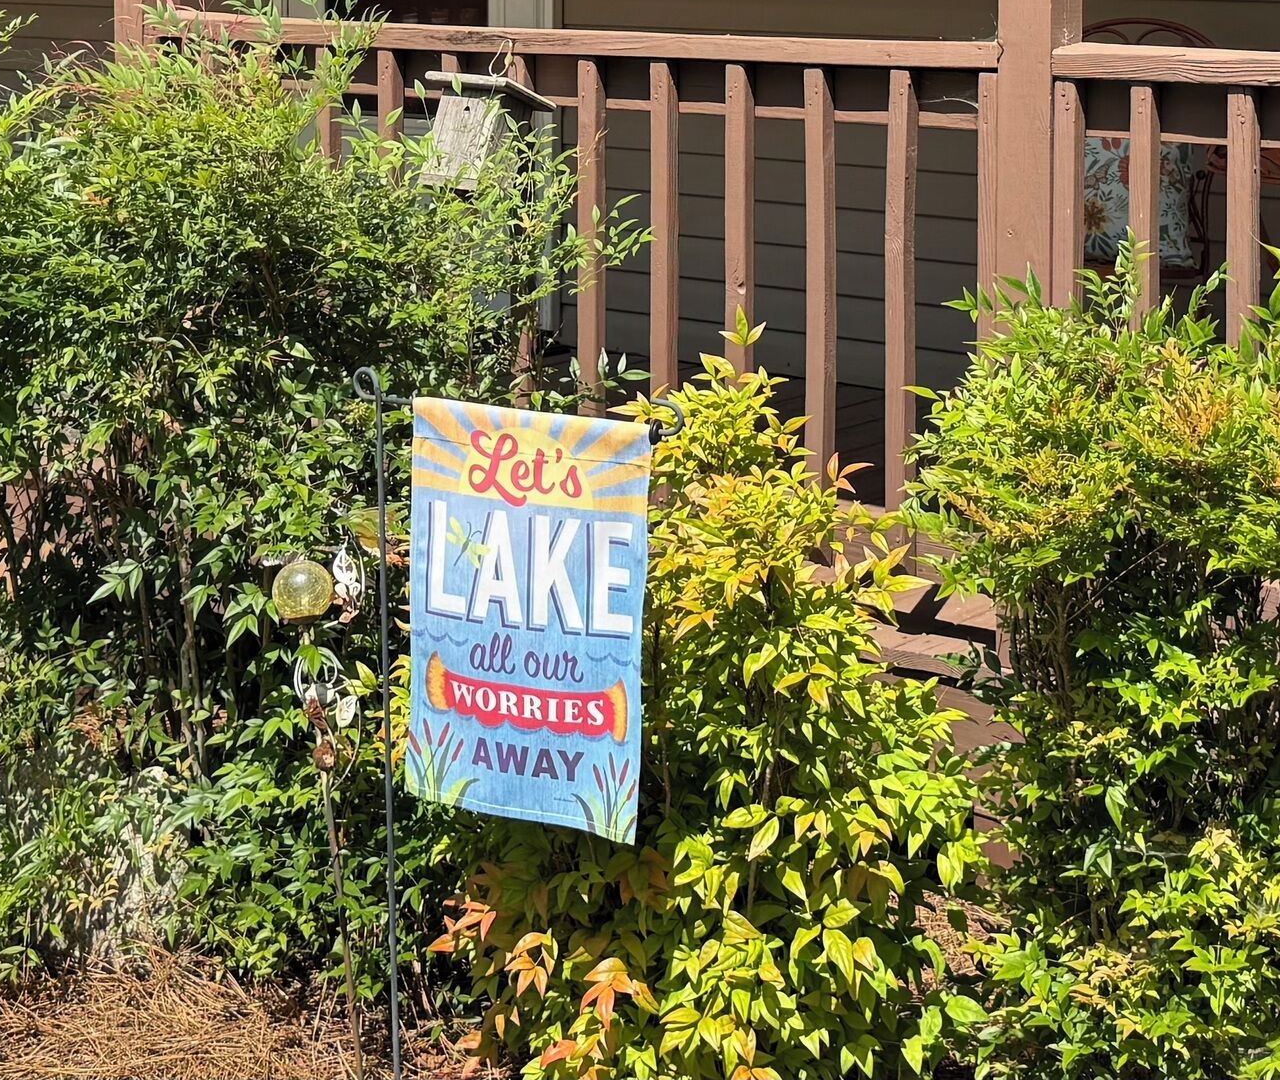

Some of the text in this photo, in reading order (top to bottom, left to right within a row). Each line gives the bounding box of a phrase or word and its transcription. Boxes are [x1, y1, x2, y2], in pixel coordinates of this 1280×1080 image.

[468, 429, 583, 507] Let's
[425, 500, 634, 639] LAKE
[469, 632, 585, 684] all our
[450, 678, 605, 727] WORRIES
[472, 736, 586, 783] AWAY
